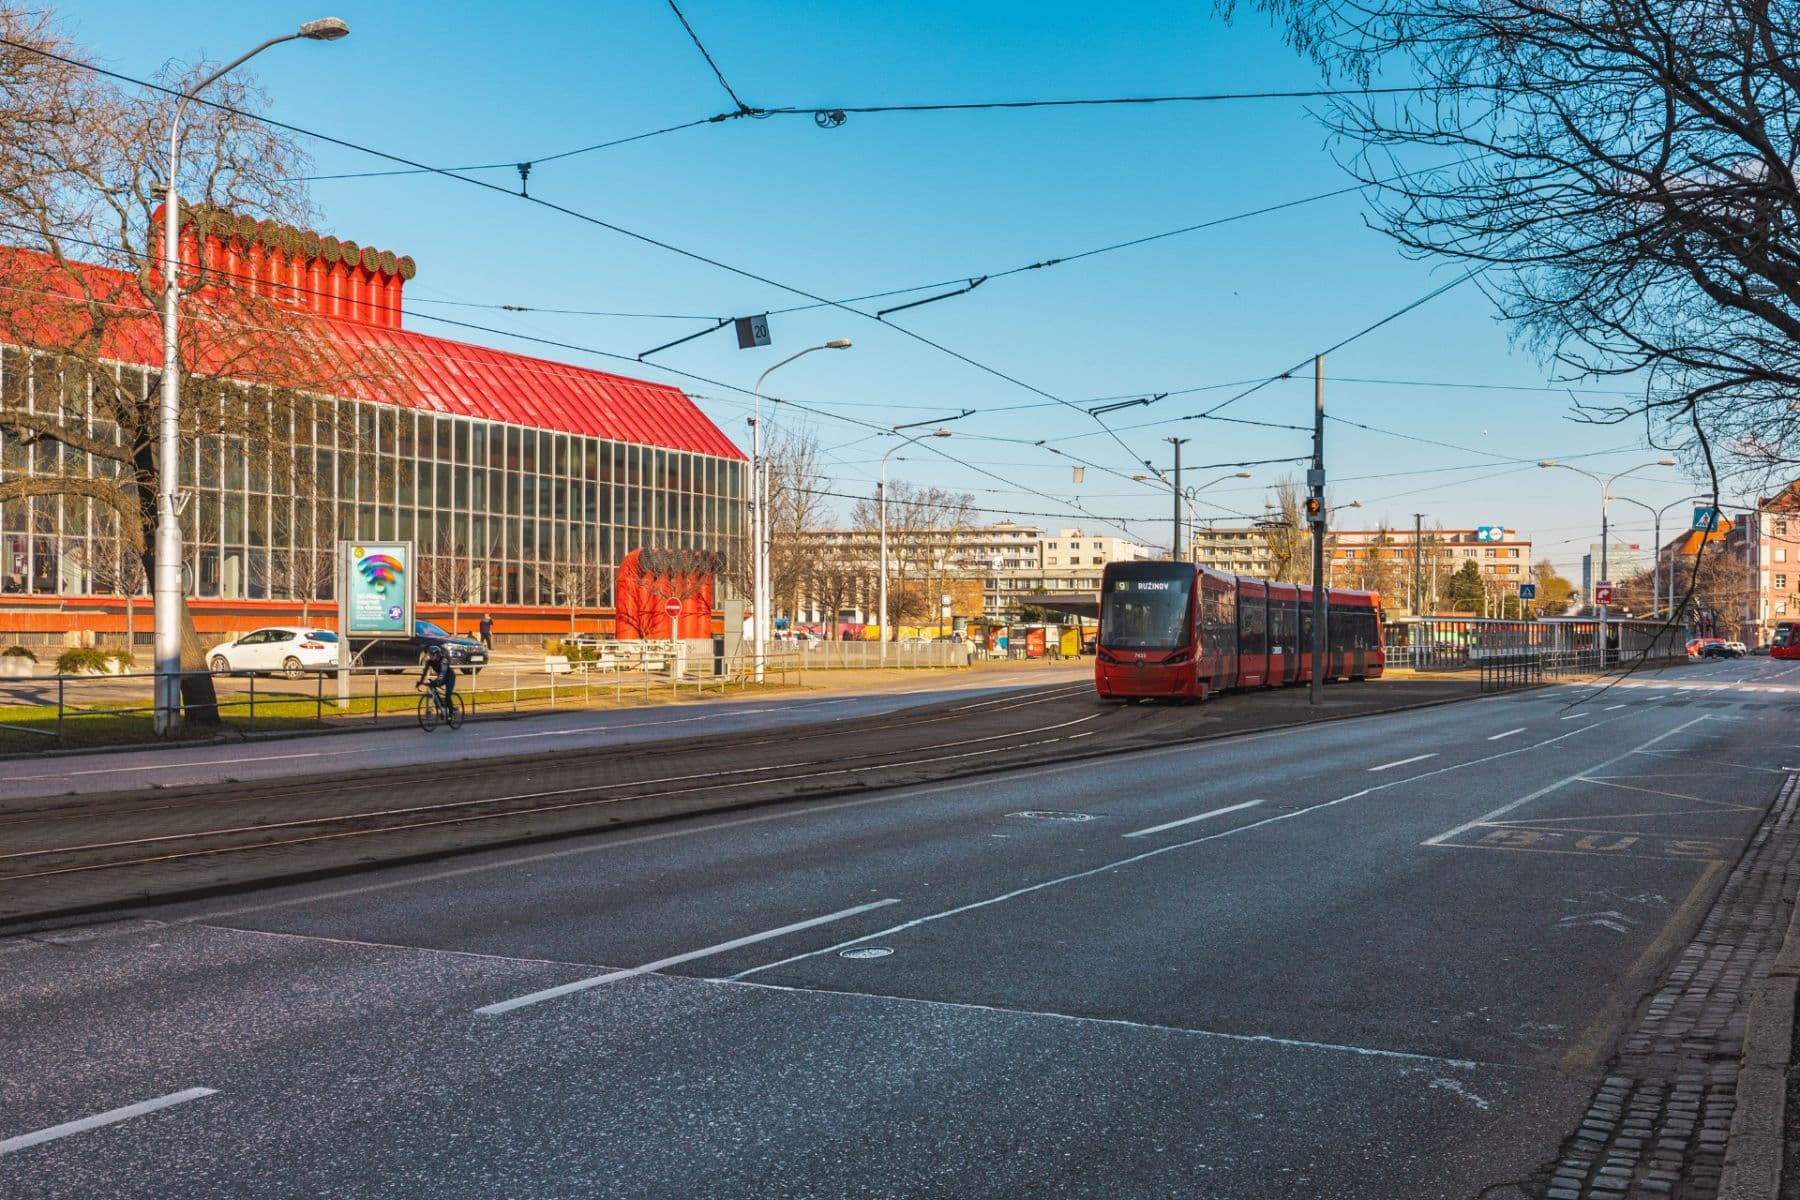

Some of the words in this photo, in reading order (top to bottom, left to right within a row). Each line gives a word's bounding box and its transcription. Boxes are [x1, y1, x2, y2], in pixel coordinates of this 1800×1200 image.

[755, 325, 767, 338] 20
[1119, 581, 1126, 590] 9
[1138, 581, 1169, 591] RUŽINOV
[1477, 829, 1720, 857] BUS
